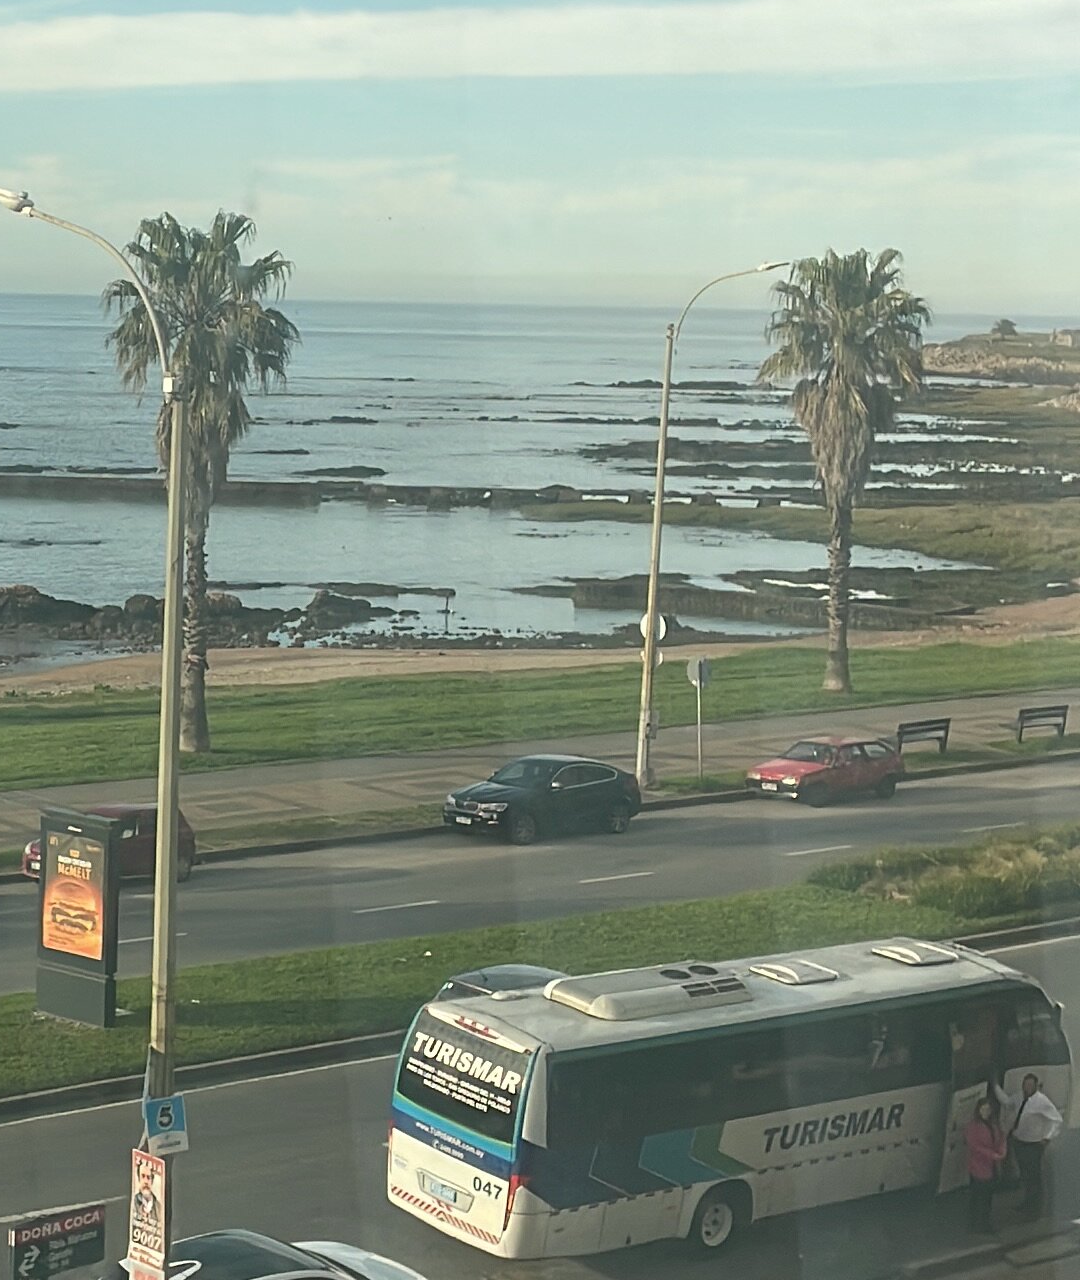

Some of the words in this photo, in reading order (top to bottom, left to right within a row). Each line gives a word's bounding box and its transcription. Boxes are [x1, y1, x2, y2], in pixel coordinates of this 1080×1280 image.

[413, 1031, 522, 1095] TURISMAR
[158, 1106, 173, 1128] 5
[764, 1103, 905, 1153] TURISMAR
[473, 1176, 502, 1200] 047
[21, 1222, 62, 1242] DOÑA
[64, 1210, 100, 1231] COCA
[132, 1228, 162, 1250] 9007
